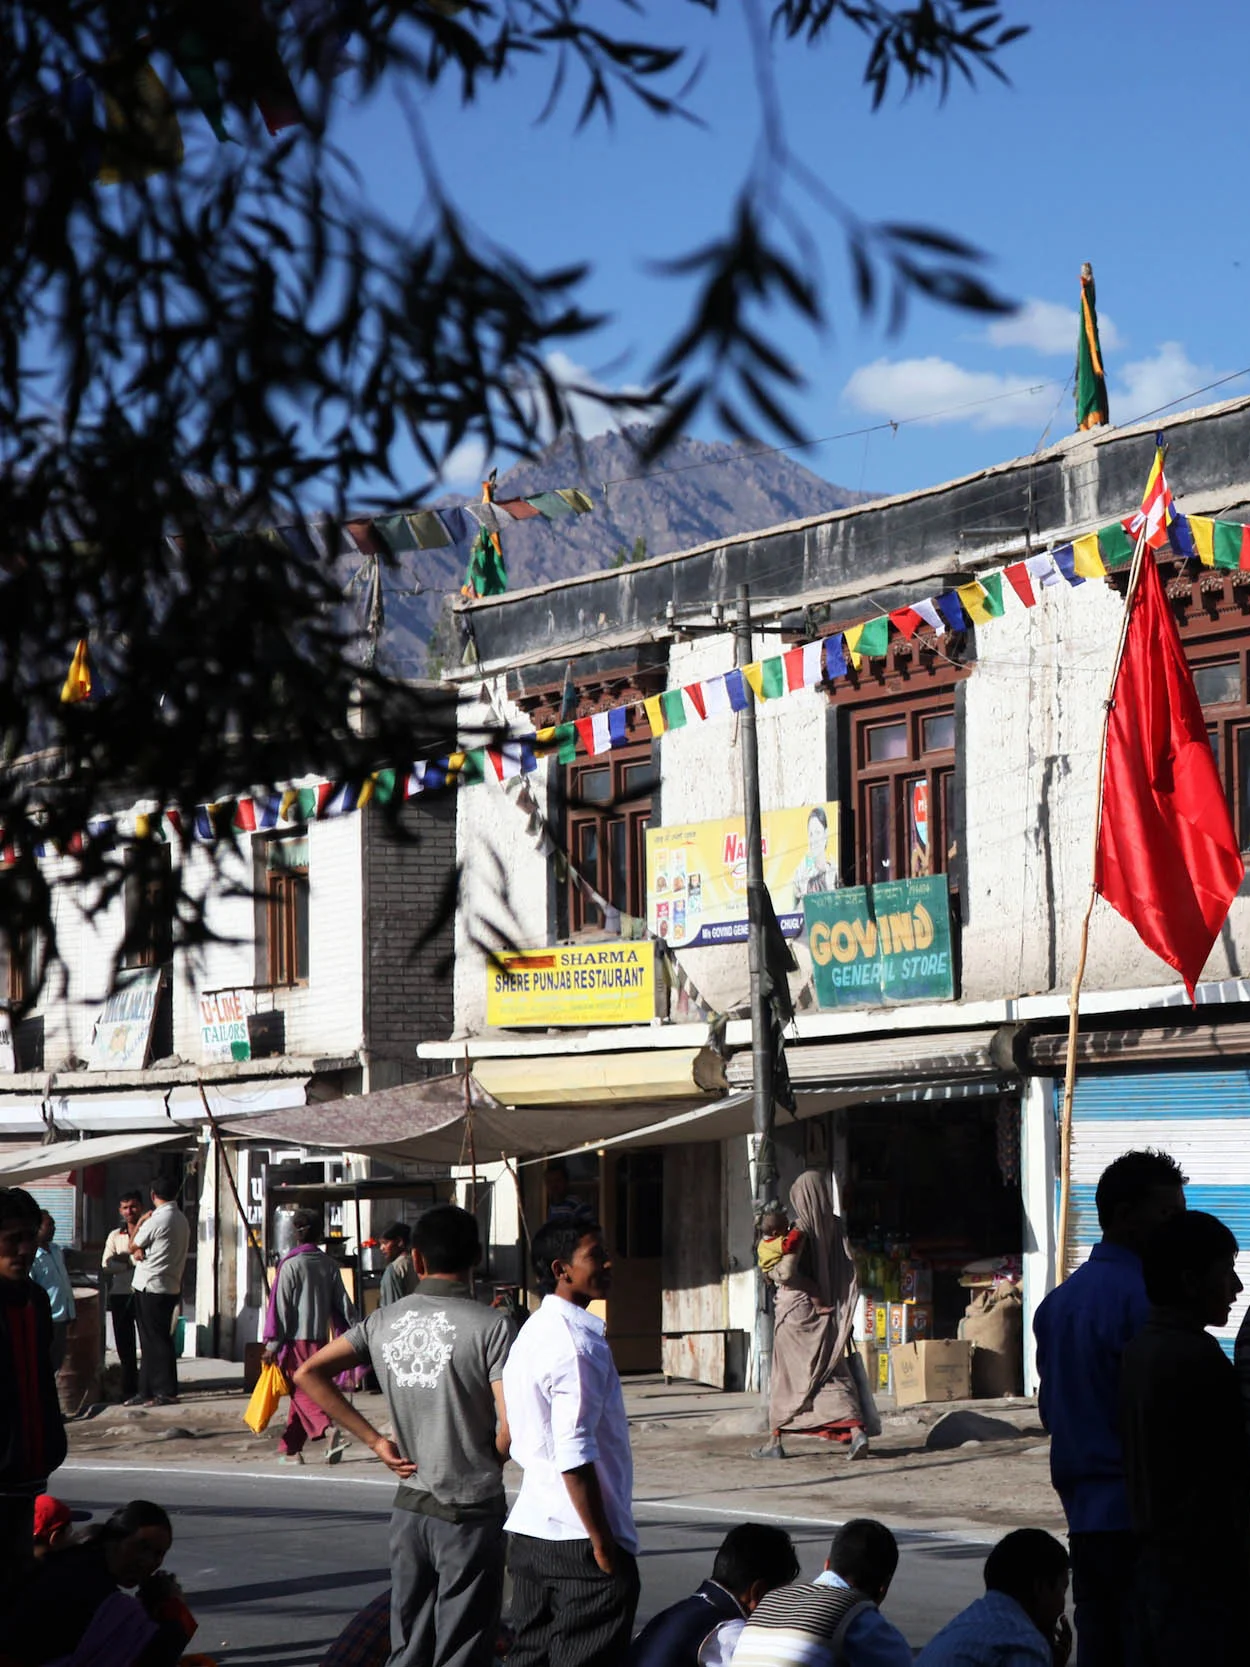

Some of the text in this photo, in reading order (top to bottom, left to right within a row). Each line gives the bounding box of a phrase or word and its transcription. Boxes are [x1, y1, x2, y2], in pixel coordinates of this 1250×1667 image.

[712, 926, 733, 938] GOVIND
[733, 924, 749, 936] GENE
[810, 902, 935, 966] GOVIND
[561, 950, 638, 966] SHARMA
[832, 951, 948, 987] GENERAL STORE
[495, 967, 645, 992] SHERE PUNJAB RESTAURANT
[201, 996, 244, 1025] U-LINE
[202, 1022, 247, 1043] TAILORS
